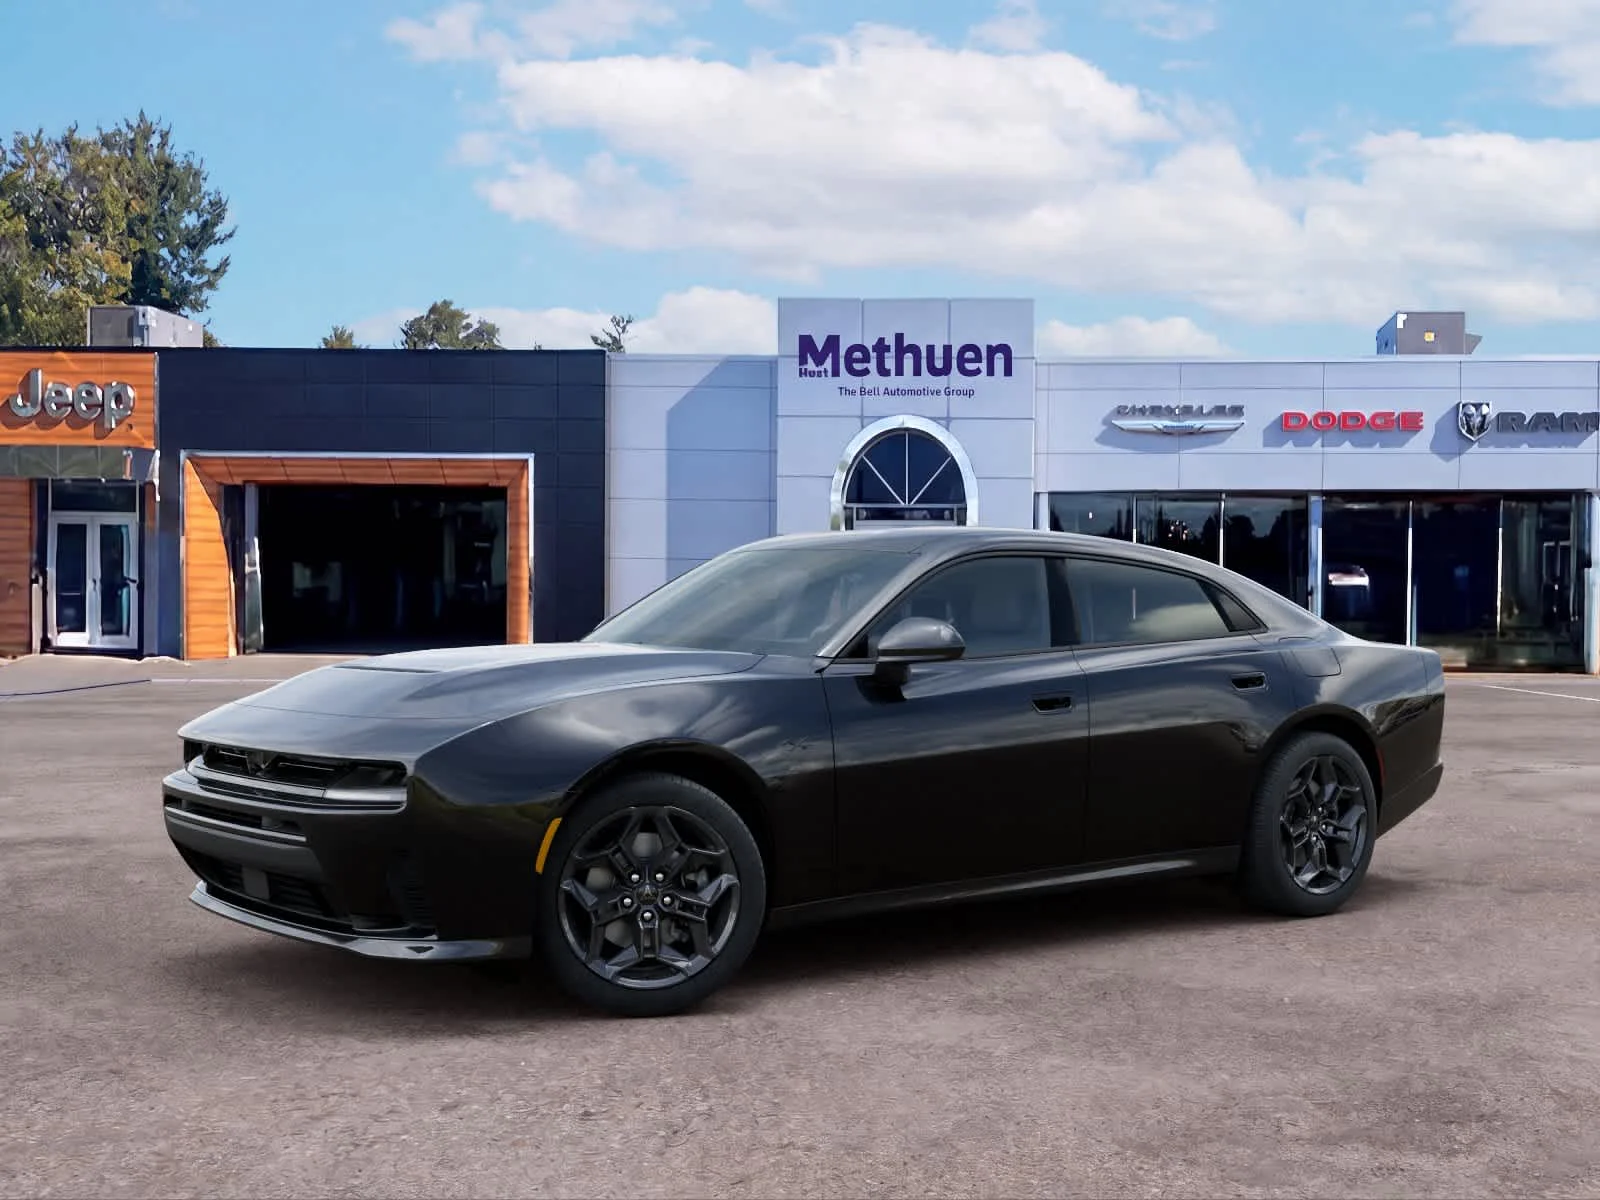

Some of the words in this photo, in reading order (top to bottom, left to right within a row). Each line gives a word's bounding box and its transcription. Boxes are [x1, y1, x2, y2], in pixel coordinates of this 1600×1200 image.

[798, 333, 1013, 378] Methuen
[10, 368, 135, 429] Jeep
[838, 386, 857, 397] The
[860, 386, 880, 397] Bell
[883, 386, 942, 397] Automotive
[944, 386, 975, 399] Group
[1282, 411, 1424, 432] DODGE
[1497, 411, 1600, 433] RAM
